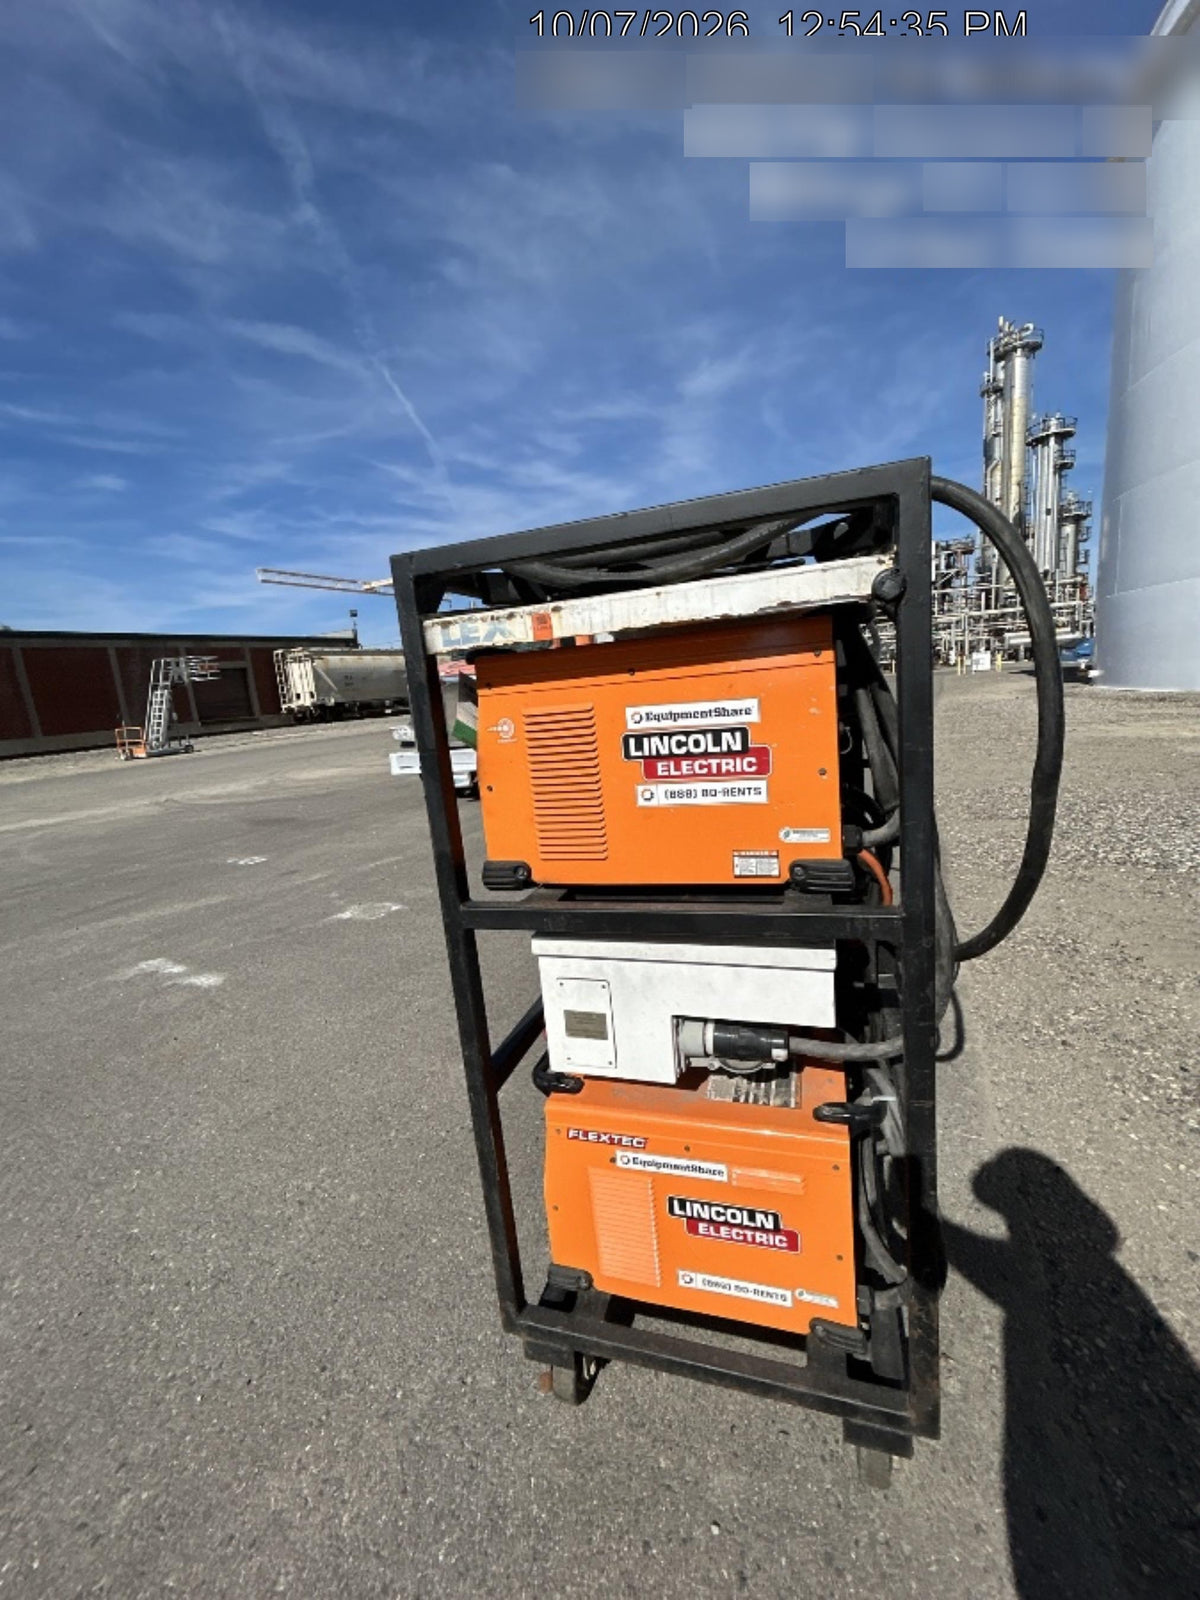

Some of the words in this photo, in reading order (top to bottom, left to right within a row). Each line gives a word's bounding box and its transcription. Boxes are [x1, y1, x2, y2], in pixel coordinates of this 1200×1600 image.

[645, 706, 752, 723] EquipmentShare
[628, 731, 742, 757] LINCOLN
[656, 757, 758, 776] ELECTRIC
[567, 1127, 646, 1149] FLEXTEC
[631, 1156, 725, 1178] EquipmentShare
[672, 1198, 775, 1230] LINCOLN
[697, 1222, 788, 1248] ELECTRIC
